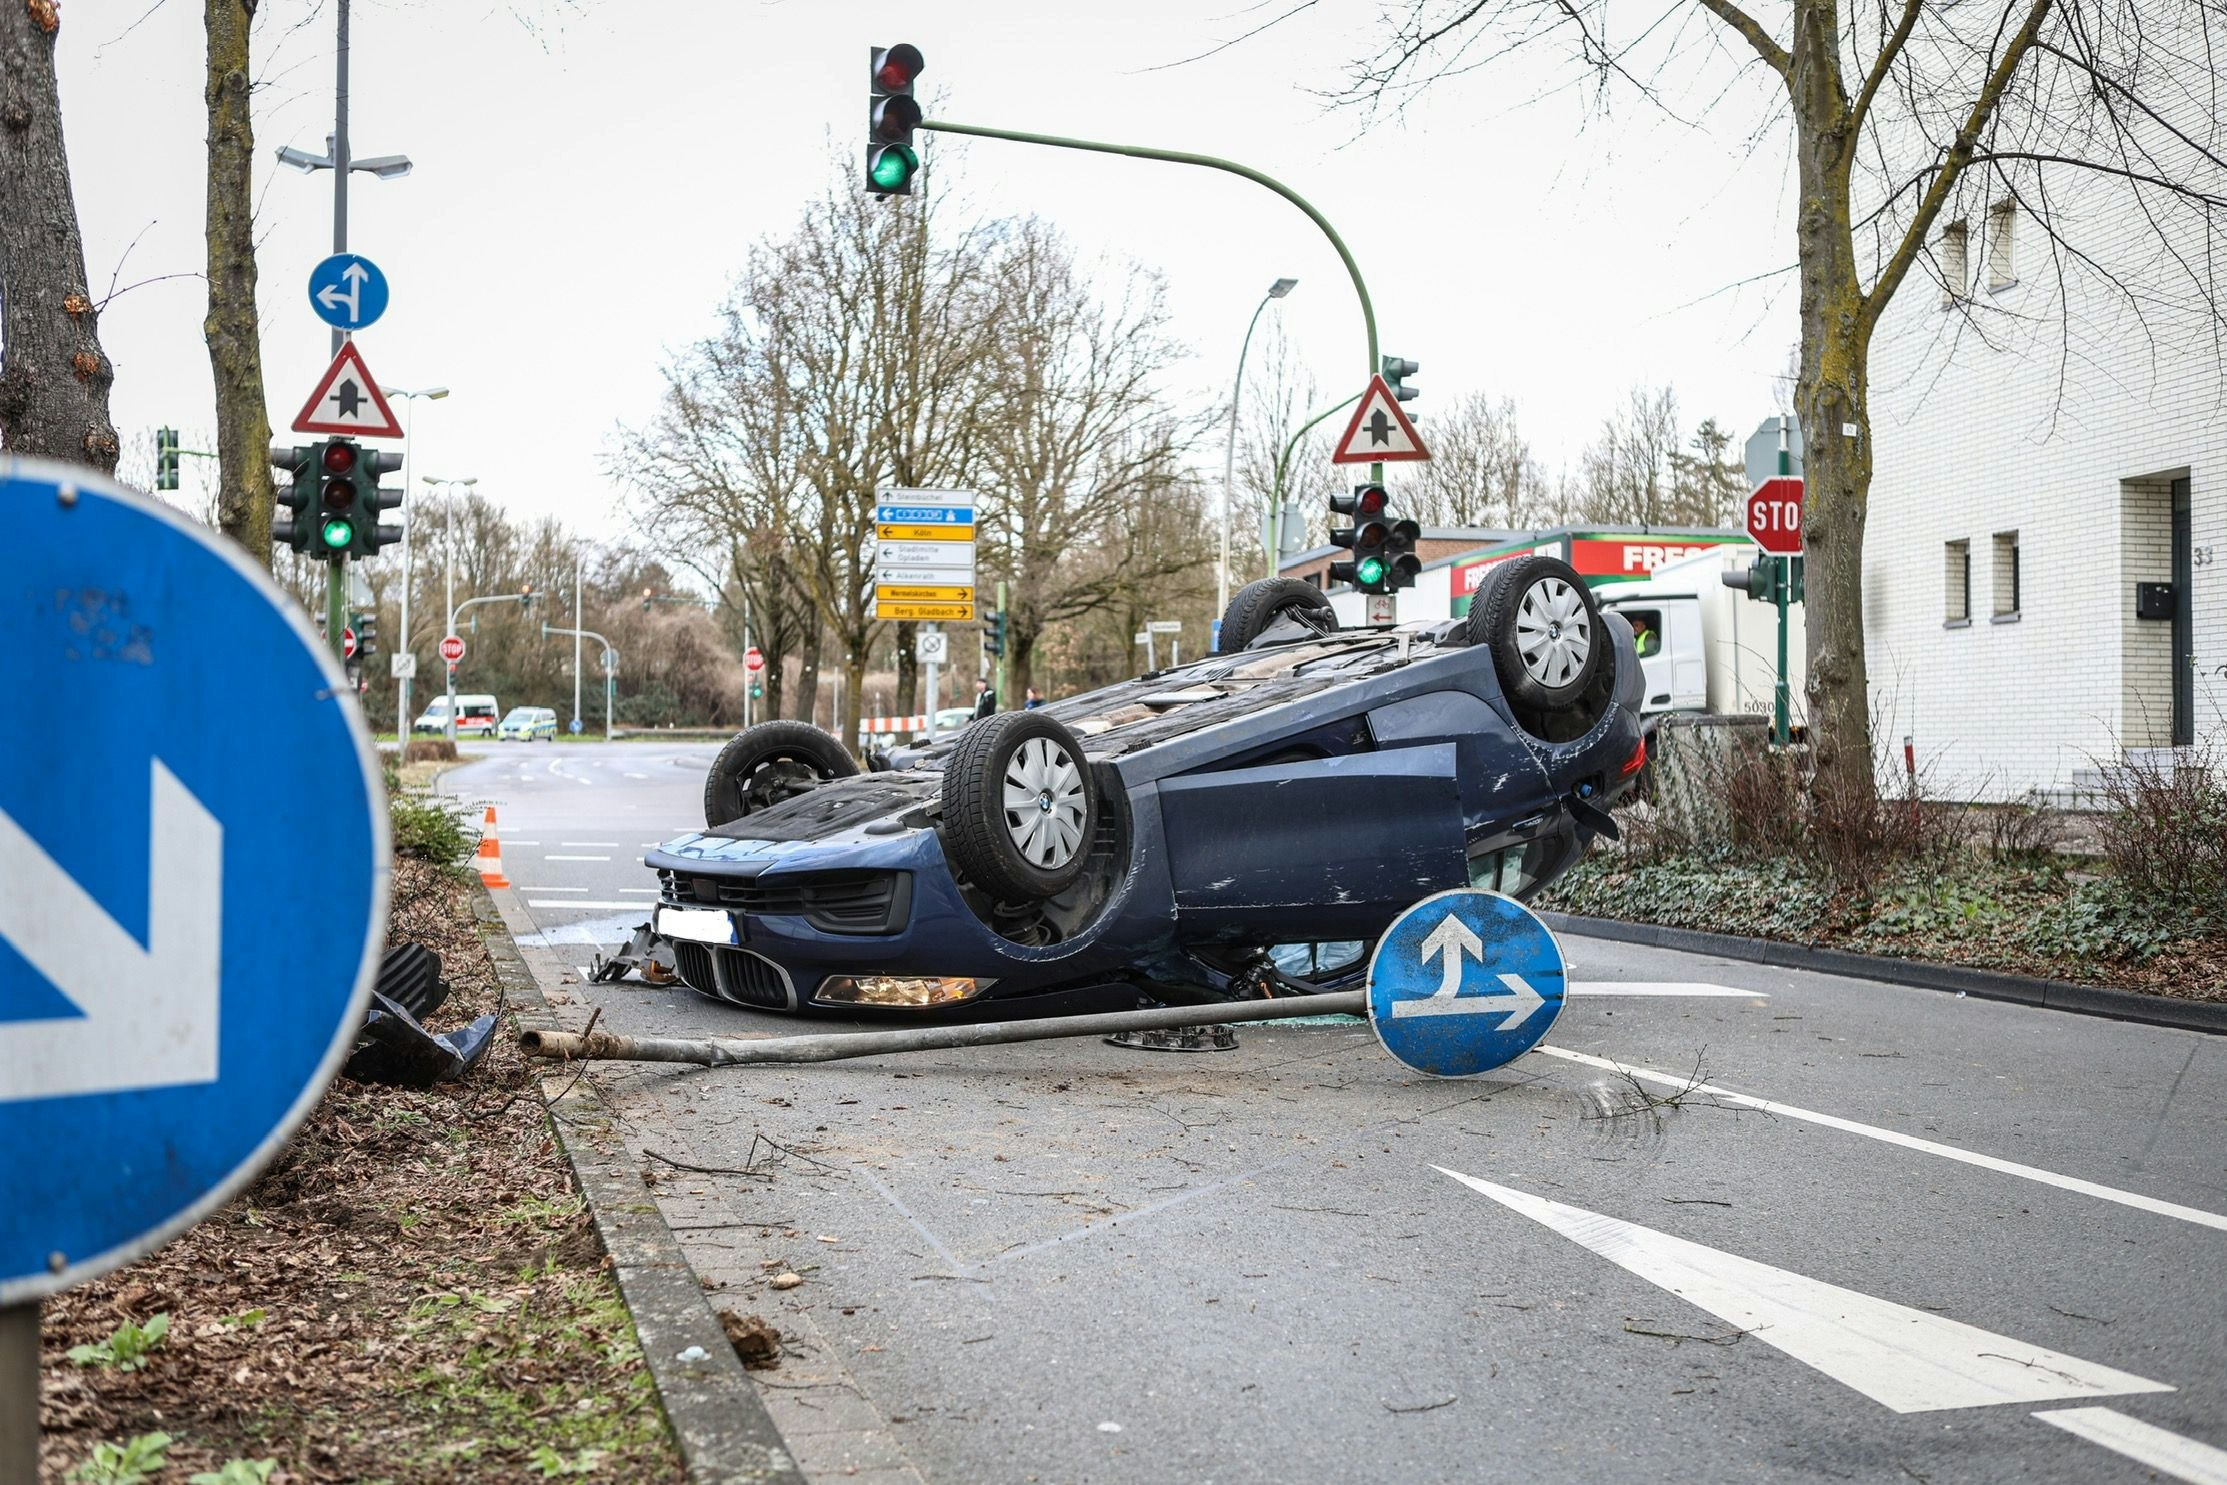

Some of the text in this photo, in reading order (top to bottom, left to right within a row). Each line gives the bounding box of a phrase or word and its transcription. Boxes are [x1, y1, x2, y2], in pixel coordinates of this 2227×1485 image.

[1753, 501, 1799, 532] STO
[913, 529, 932, 537] Köln
[898, 554, 930, 562] Opladen
[2194, 547, 2212, 566] 33
[918, 607, 955, 616] Gladbach
[442, 643, 462, 655] STOP
